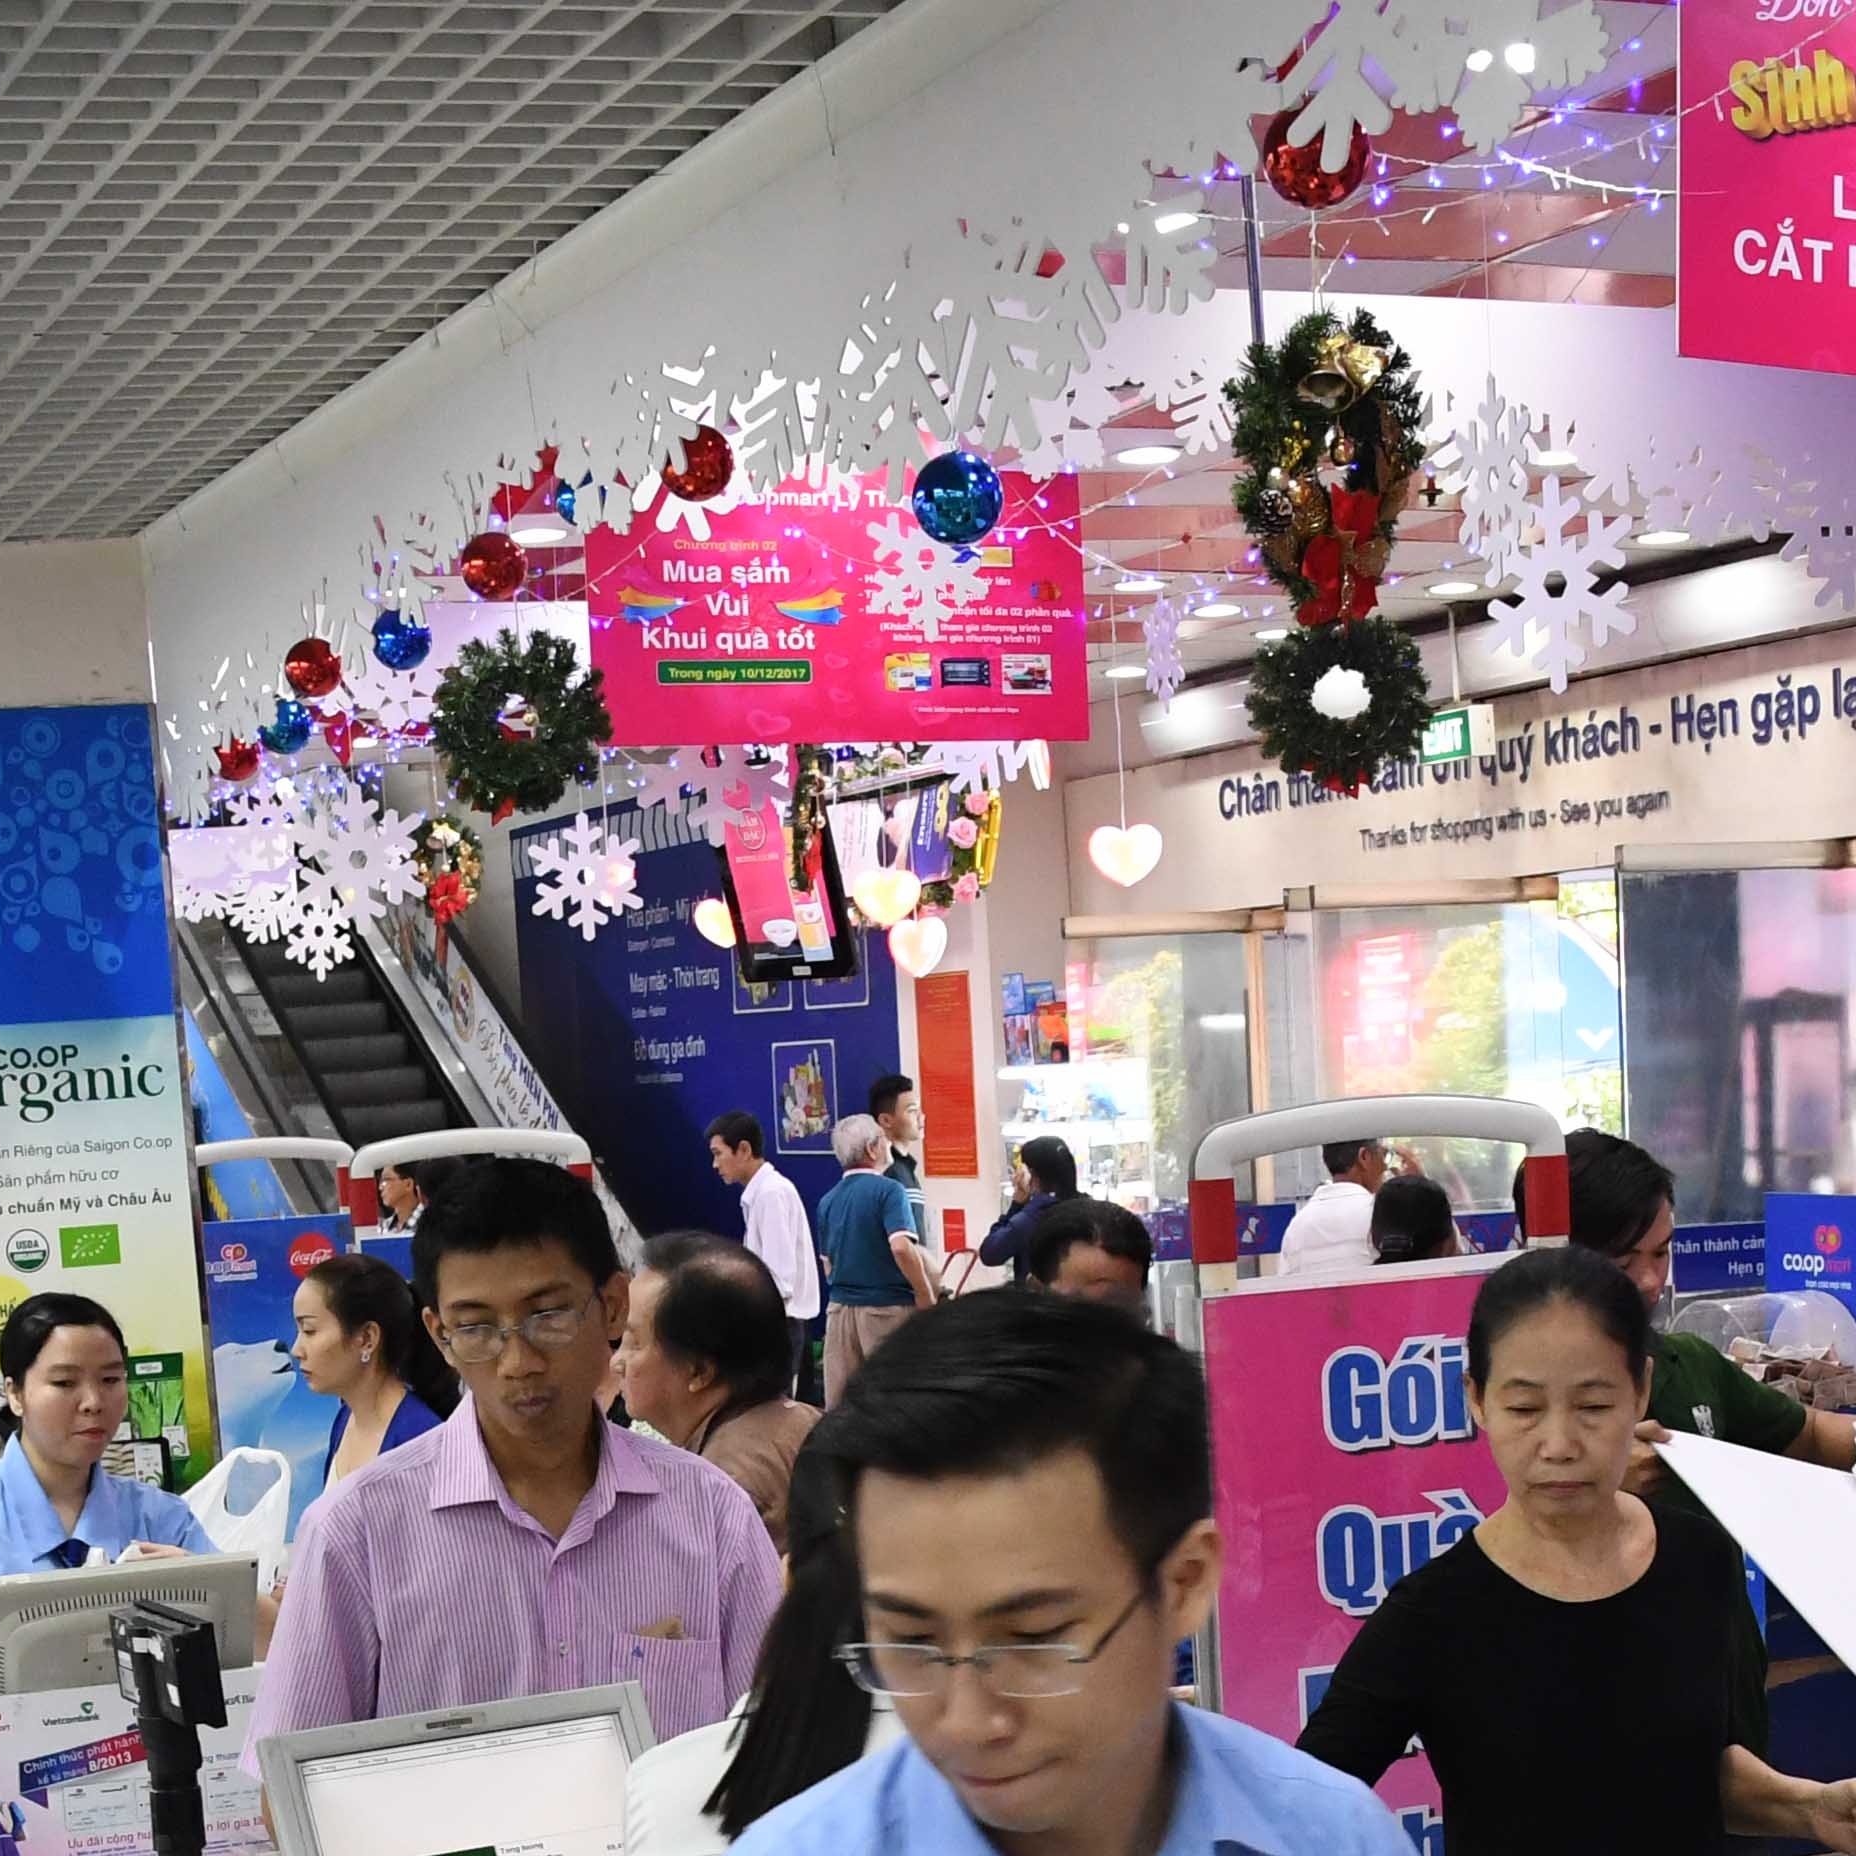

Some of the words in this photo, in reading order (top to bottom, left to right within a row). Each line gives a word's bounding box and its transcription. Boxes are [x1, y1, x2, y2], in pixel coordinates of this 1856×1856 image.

[1733, 217, 1834, 284] CẮT
[662, 559, 723, 583] Mua
[731, 556, 791, 584] sắm
[705, 593, 750, 617] Vui
[641, 627, 708, 650] Khui
[715, 627, 770, 655] quà
[776, 624, 817, 651] tốt
[667, 667, 704, 680] Trong
[706, 667, 737, 681] ngày
[739, 667, 807, 680] 10/12/2017
[1218, 772, 1282, 821] Chân
[1543, 706, 1641, 767] khách
[1670, 694, 1741, 755] Hẹn
[1749, 673, 1822, 747] gặp
[1358, 826, 1409, 852] Thanks
[1409, 821, 1429, 845] for
[1429, 815, 1494, 848] shopping
[1528, 806, 1548, 829] us
[1558, 798, 1592, 825] See
[1593, 795, 1624, 827] you
[1625, 787, 1673, 820] again
[13, 1142, 53, 1160] Riêng
[55, 1140, 80, 1155] của
[82, 1138, 130, 1155] Saigon
[132, 1136, 173, 1154] Co.op
[25, 1167, 66, 1189] phẩm
[68, 1167, 98, 1183] hữu
[100, 1168, 120, 1181] cơ
[7, 1195, 56, 1216] chuẩn
[58, 1196, 83, 1214] Mỹ
[85, 1195, 105, 1209] và
[107, 1193, 148, 1208] Châu
[151, 1187, 173, 1204] Âu
[14, 1238, 41, 1251] USDA
[1703, 1236, 1740, 1252] thành
[1727, 1258, 1753, 1278] Hẹn
[1319, 1334, 1475, 1453] Gói
[42, 1712, 100, 1728] Vietcombank
[58, 1748, 85, 1767] thức
[87, 1751, 132, 1773] 8/2013
[232, 1816, 251, 1832] gia
[85, 1834, 103, 1848] đãi
